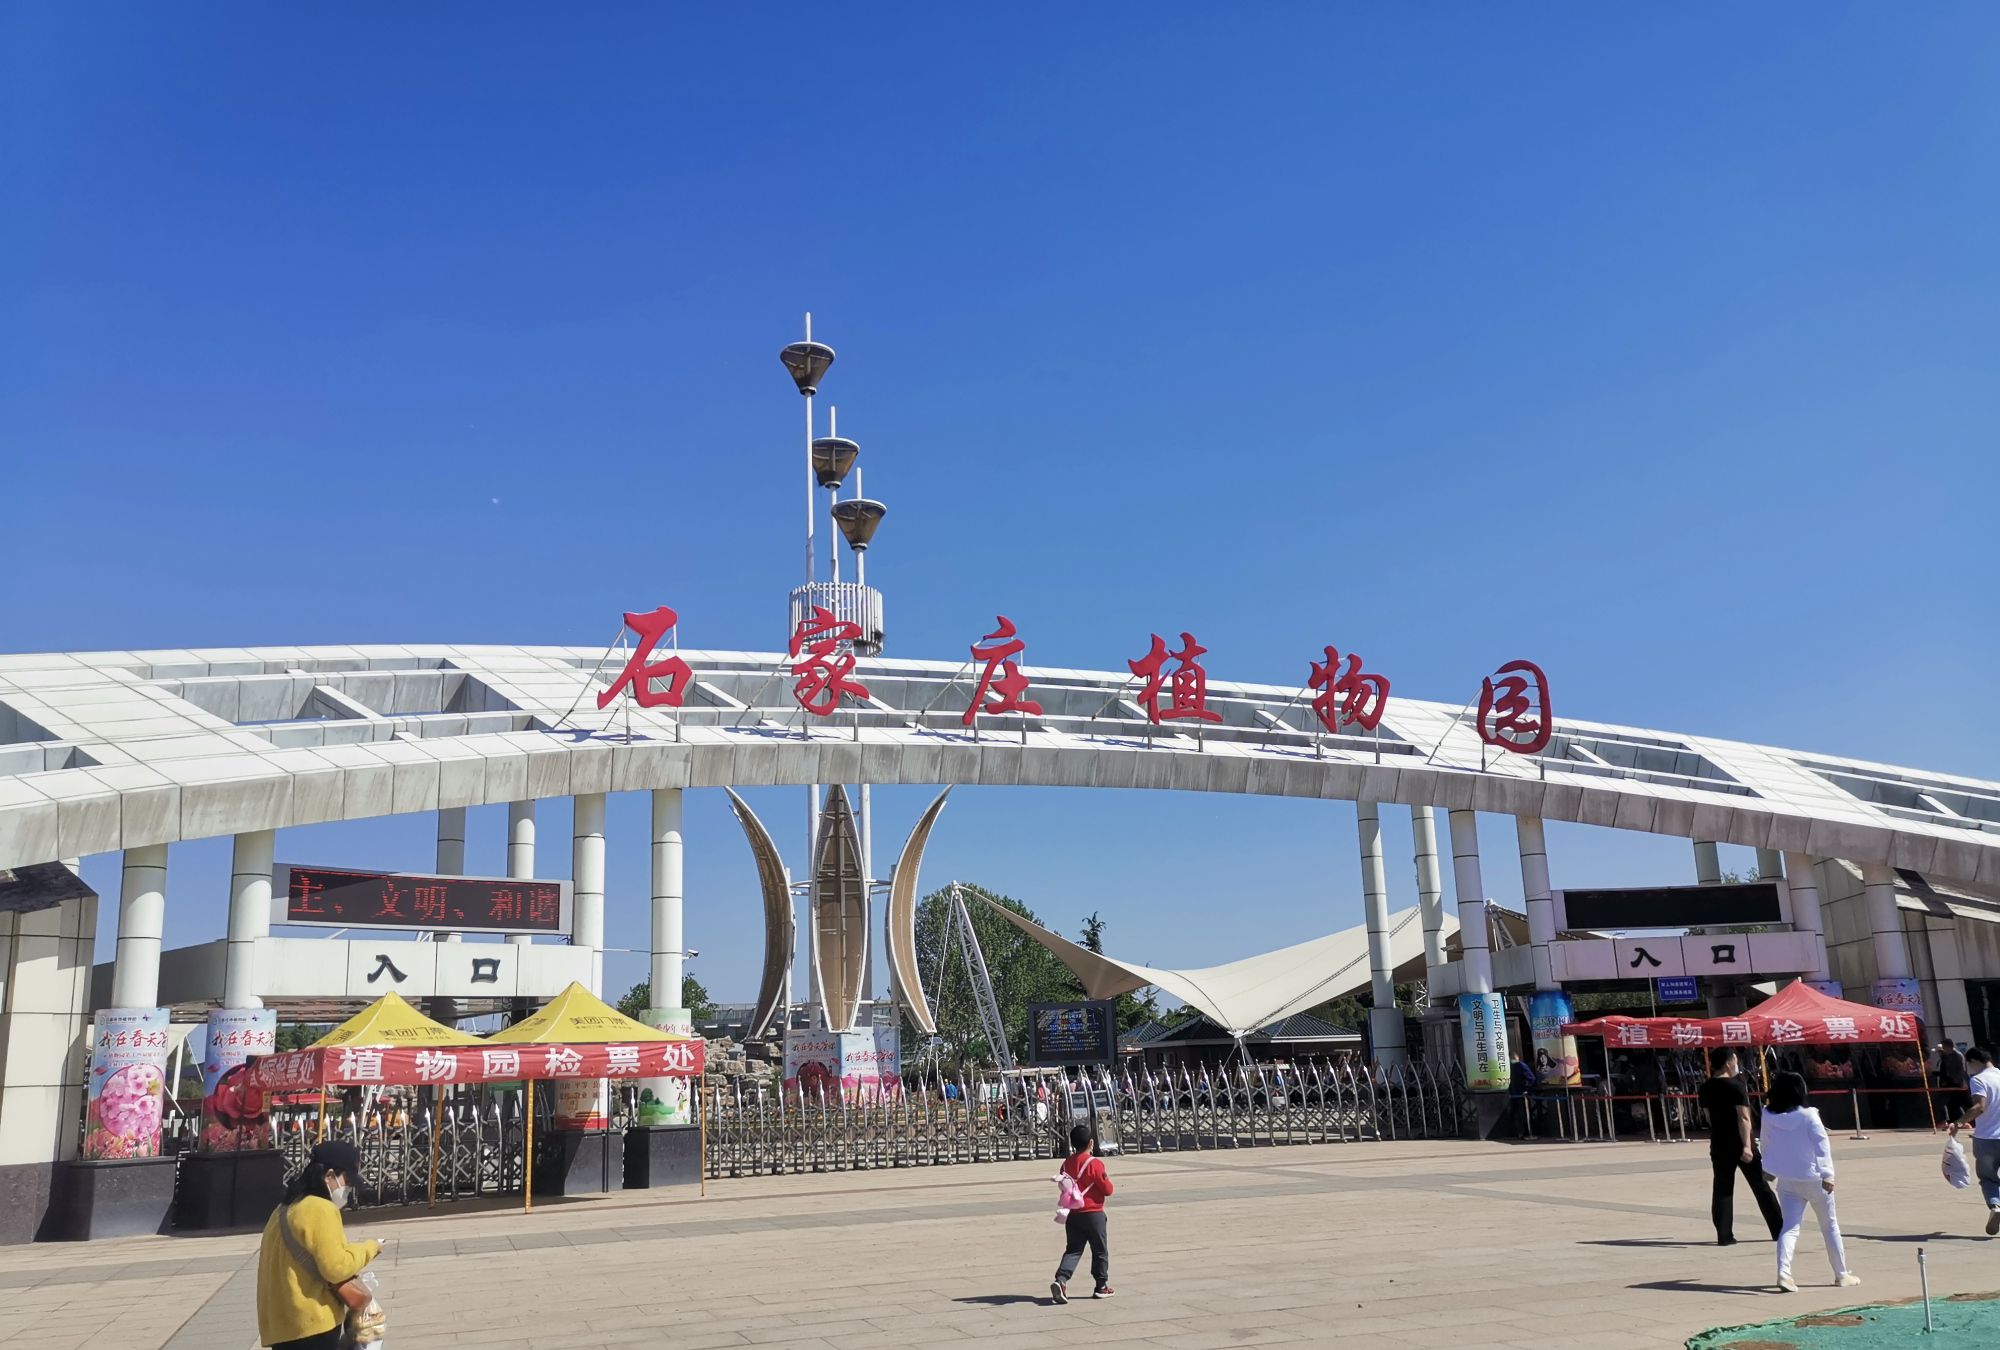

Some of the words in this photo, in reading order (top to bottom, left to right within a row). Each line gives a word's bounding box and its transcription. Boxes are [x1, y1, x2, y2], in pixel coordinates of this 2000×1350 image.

[597, 605, 1552, 752] 石家庄植物园
[367, 954, 501, 984] 入口
[1631, 944, 1736, 969] 入口
[379, 1027, 447, 1037] 美团门票
[569, 1016, 628, 1026] 美团门票
[1471, 999, 1489, 1073] 文明与卫生同在
[1491, 999, 1507, 1073] 卫生与文明同行
[1617, 1014, 1914, 1047] 植物园检票处
[338, 1044, 696, 1082] 植物园检票处
